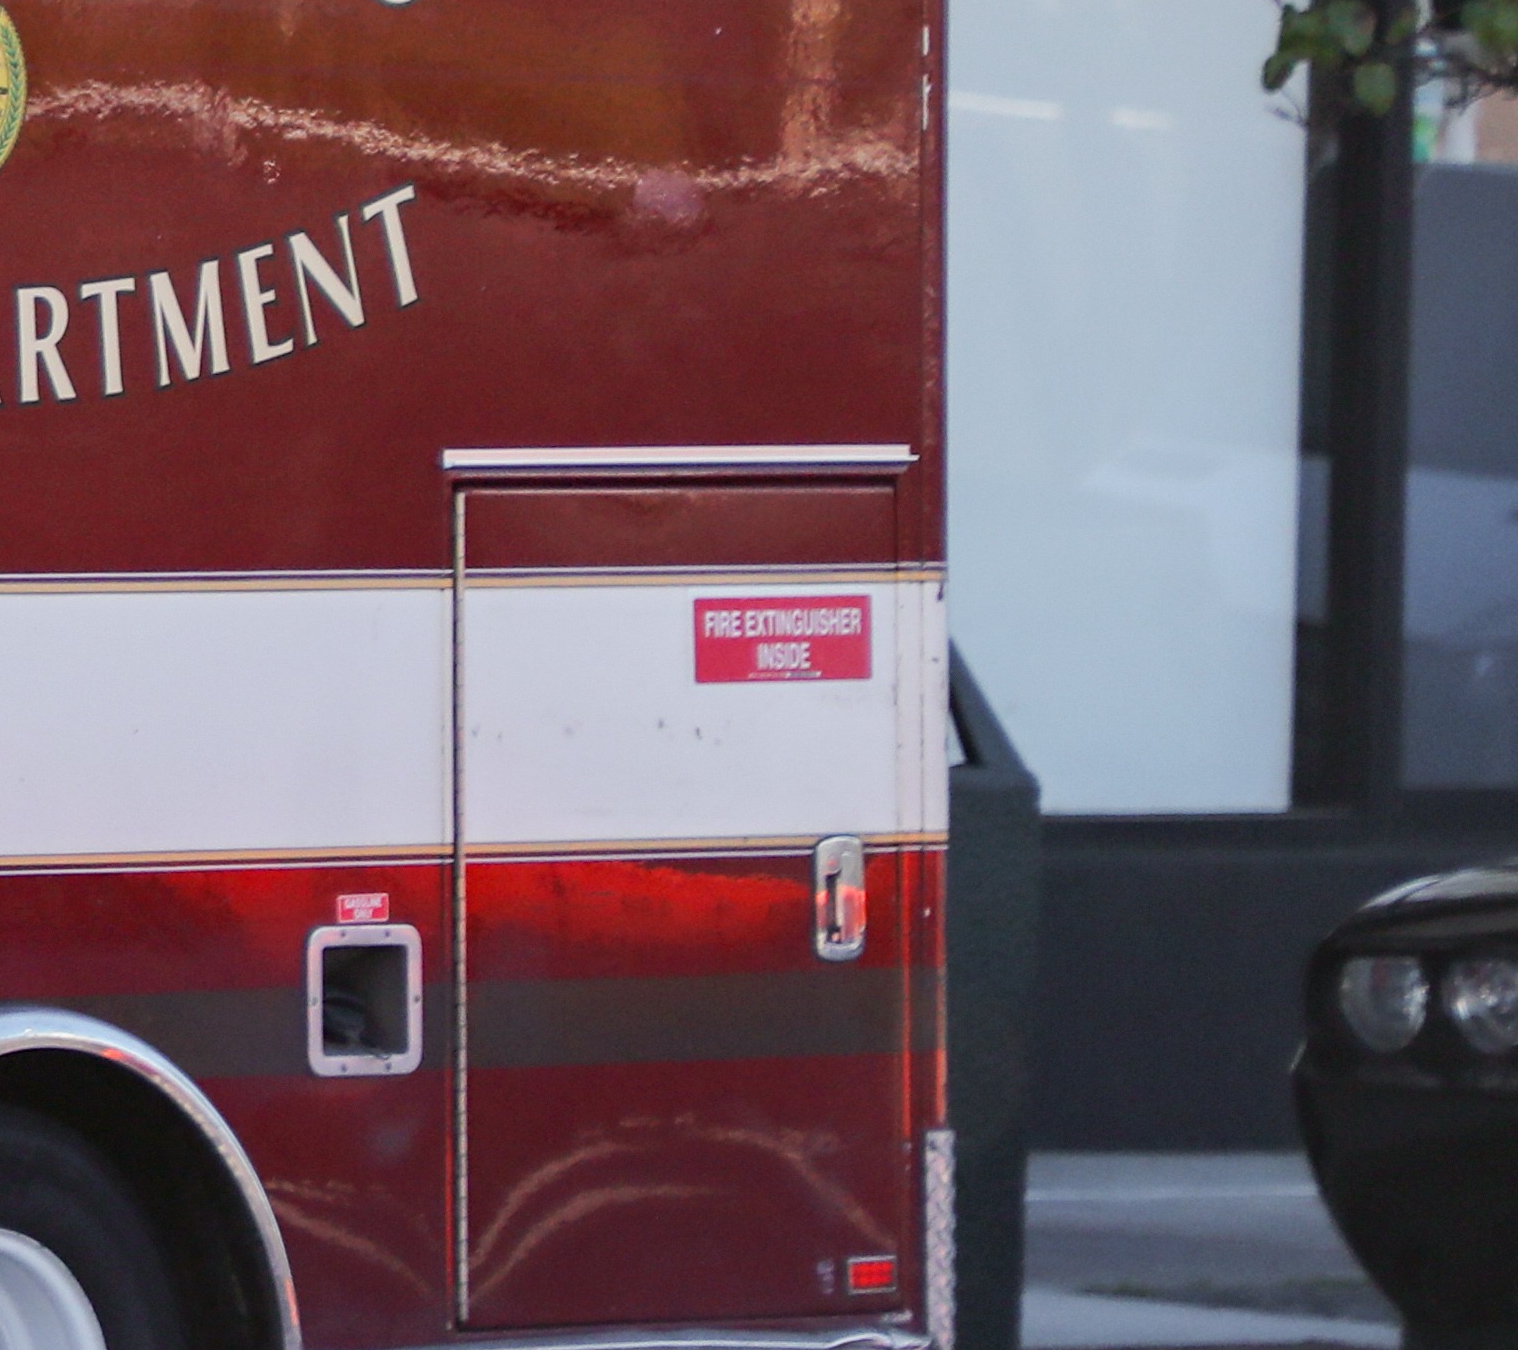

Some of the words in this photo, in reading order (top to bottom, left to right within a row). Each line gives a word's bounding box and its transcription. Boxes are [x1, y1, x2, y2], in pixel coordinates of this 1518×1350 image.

[704, 609, 743, 639] FIRE
[745, 607, 863, 638] EXTINGUISHER
[756, 641, 812, 671] INSIDE
